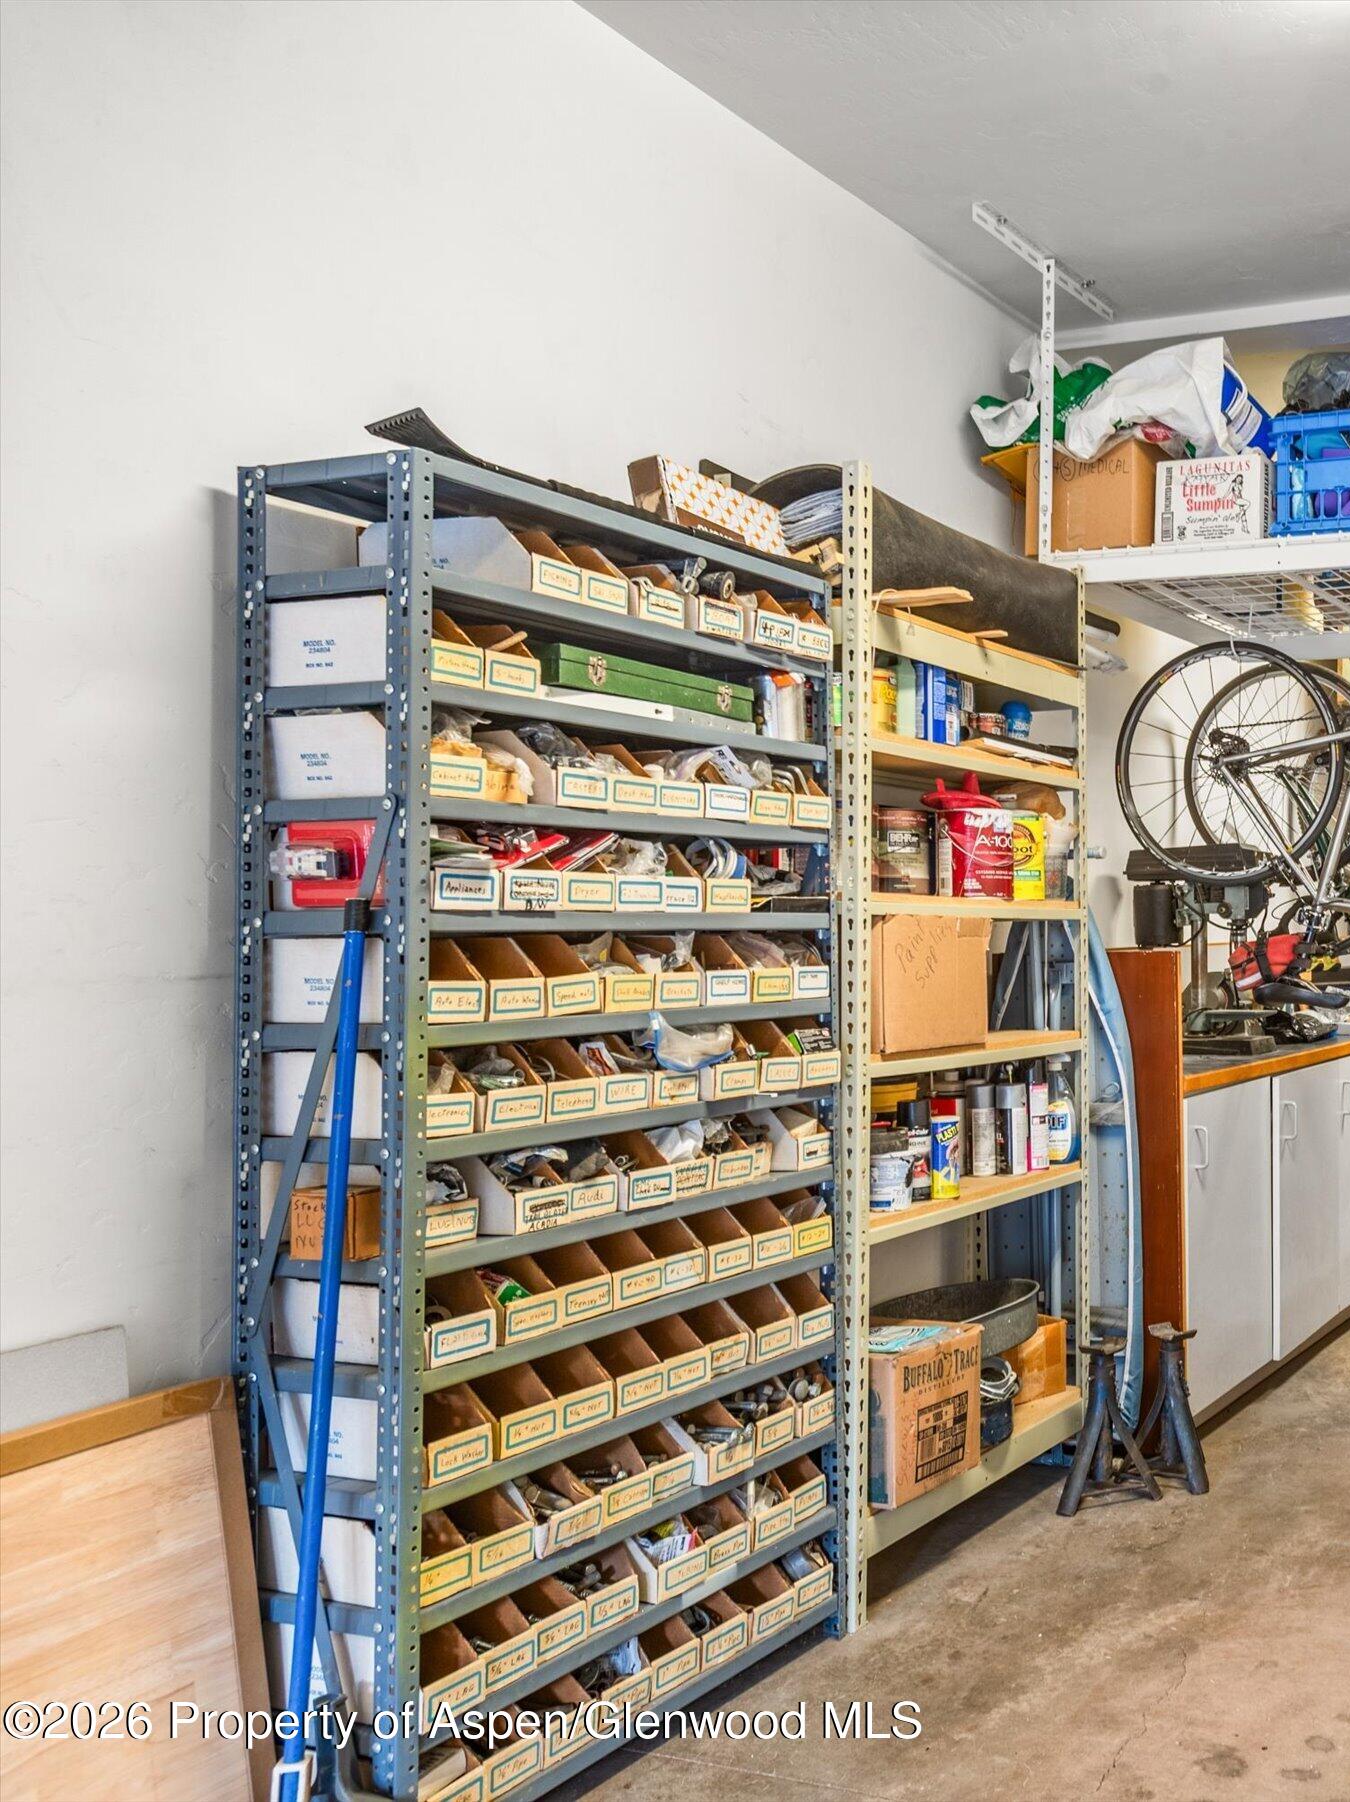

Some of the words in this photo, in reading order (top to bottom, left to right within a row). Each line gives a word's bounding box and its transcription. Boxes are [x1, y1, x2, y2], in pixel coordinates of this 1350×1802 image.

[1078, 457, 1130, 477] MEDICAL
[1179, 459, 1251, 476] LAGUNITAS
[1182, 481, 1216, 498] Little
[303, 640, 322, 648] MODEL
[324, 638, 336, 646] NO.
[300, 753, 319, 761] MODEL
[889, 833, 911, 843] BEHR
[976, 836, 1013, 849] A-100
[445, 880, 487, 895] Appliances
[574, 886, 600, 898] Dryer
[610, 1083, 639, 1100] WIRE
[427, 1107, 470, 1120] lectronics
[577, 1190, 604, 1204] Audi
[903, 1358, 945, 1393] BUFFALO
[953, 1344, 978, 1375] TRACE
[918, 1373, 965, 1396] DISTILLERY
